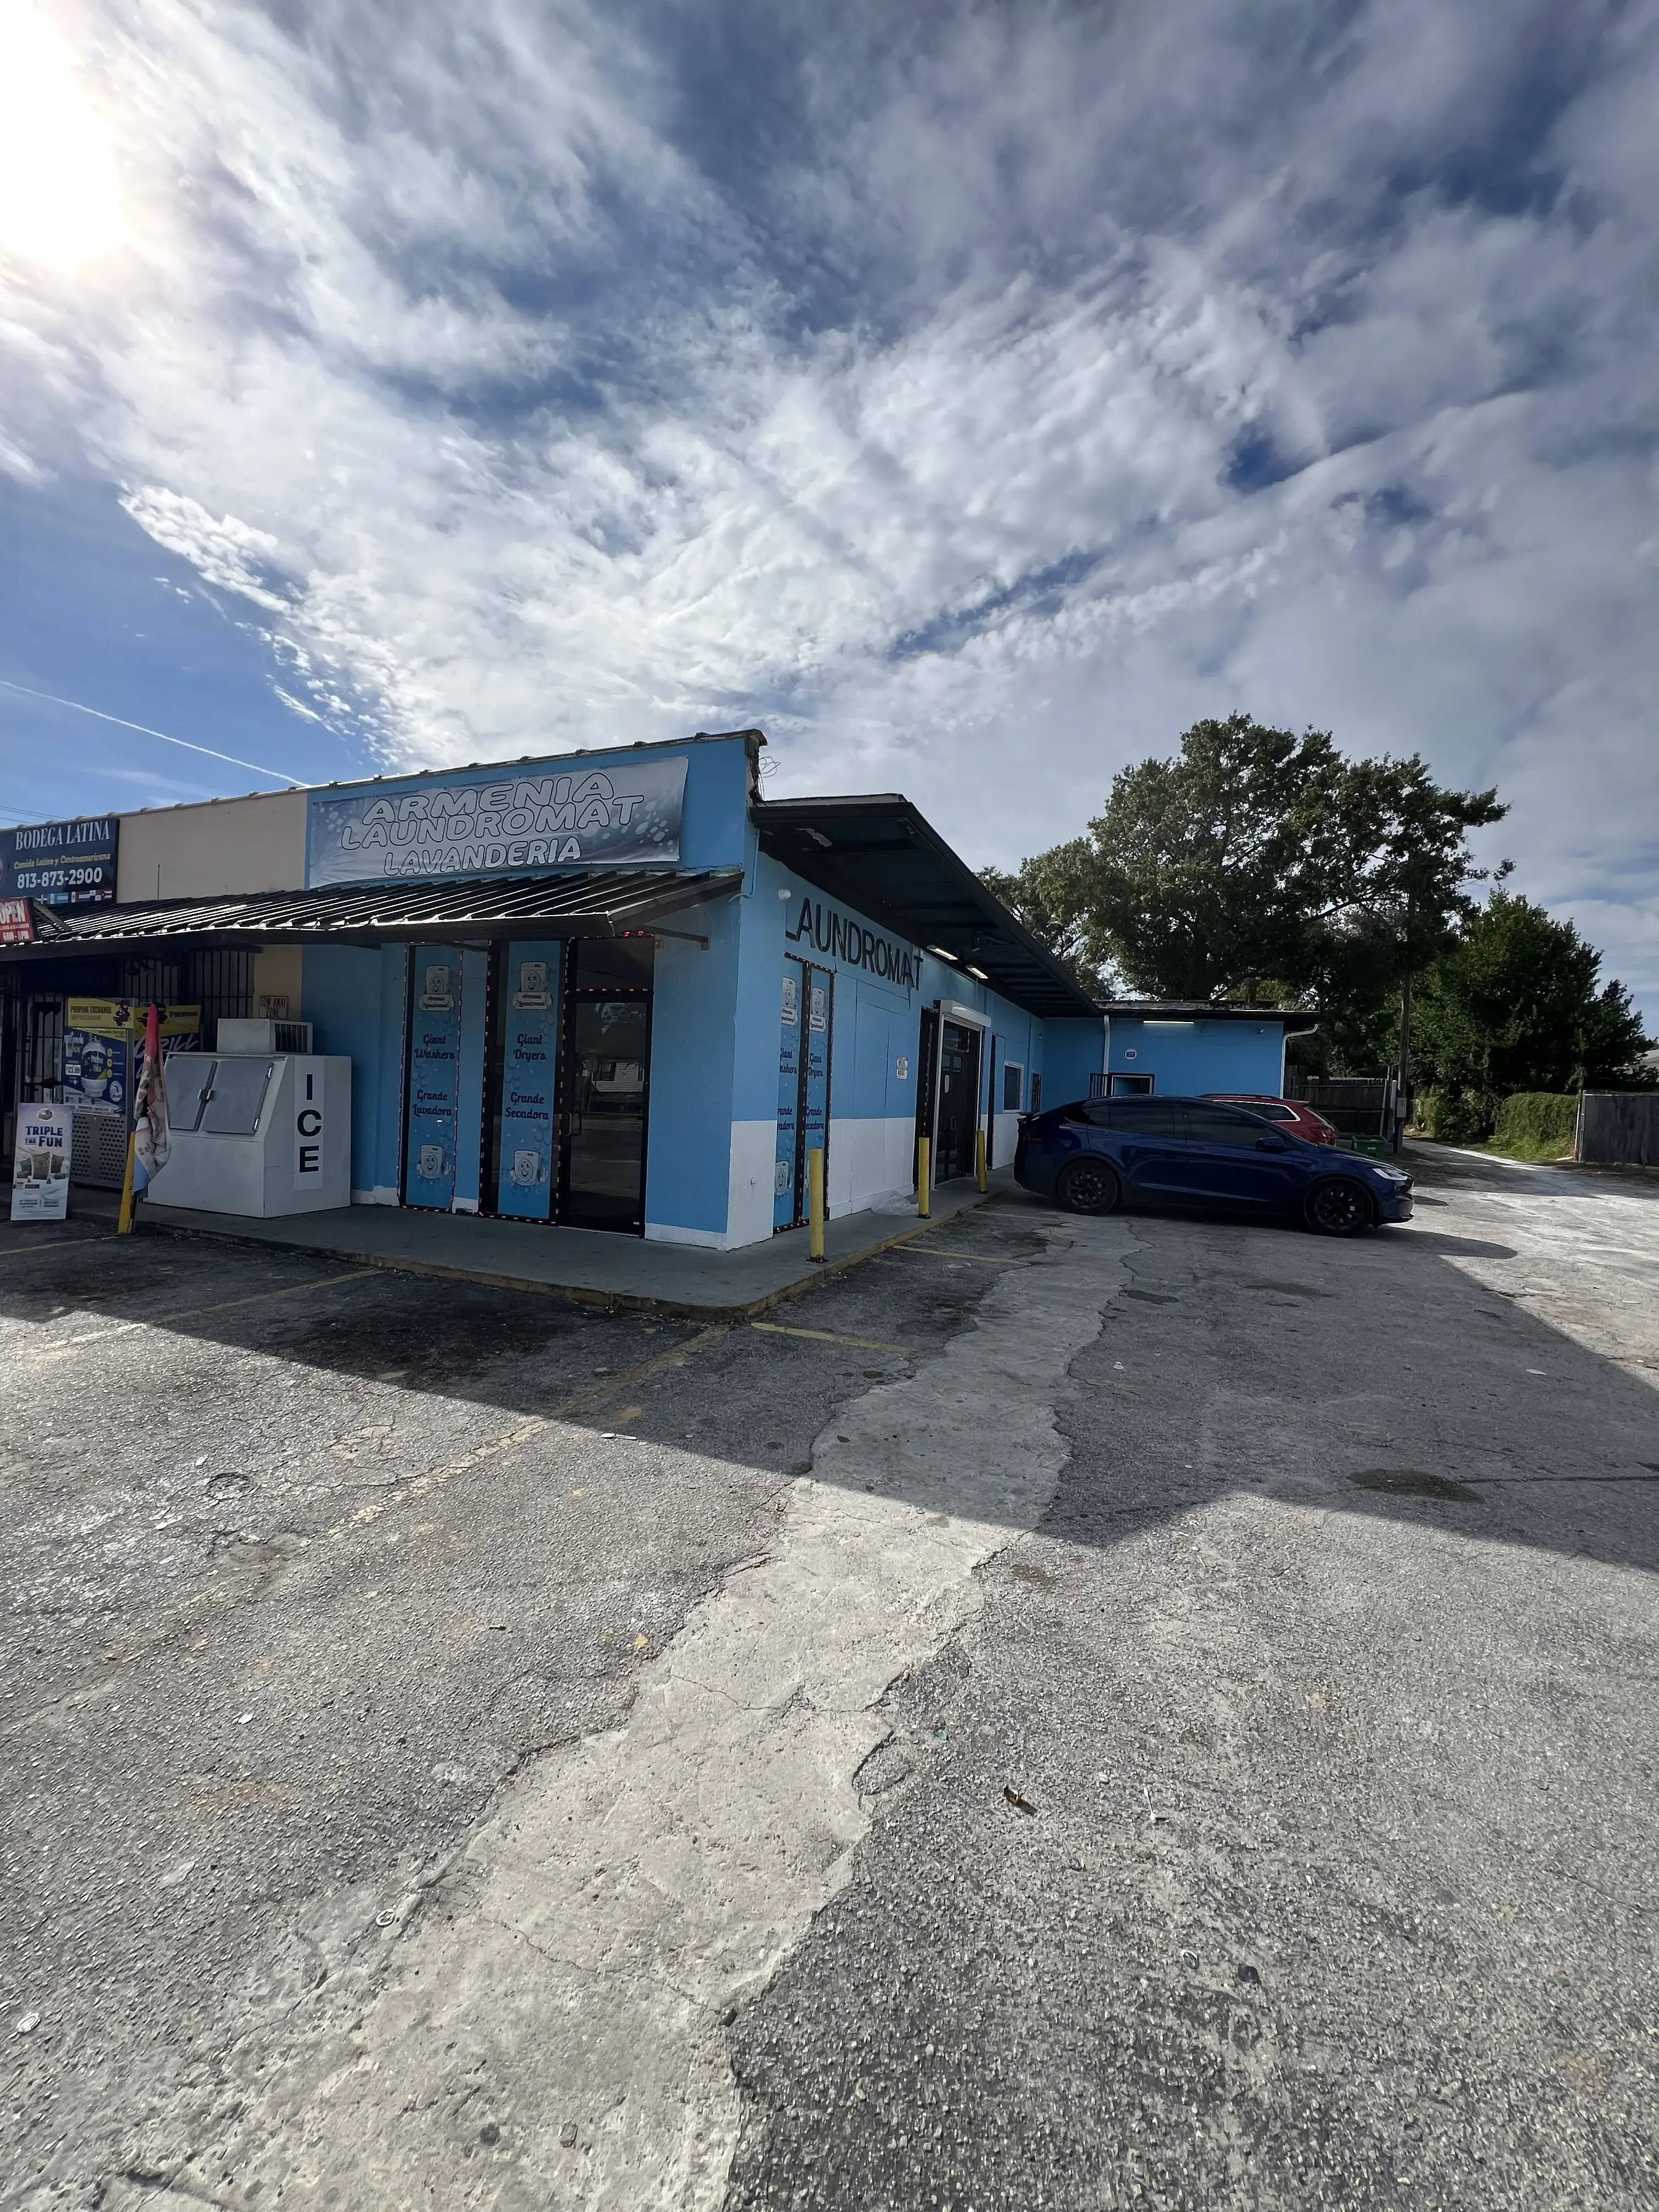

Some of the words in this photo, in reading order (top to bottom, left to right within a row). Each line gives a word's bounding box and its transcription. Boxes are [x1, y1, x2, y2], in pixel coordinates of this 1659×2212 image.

[363, 772, 614, 826] ARMENIA
[341, 795, 645, 850] LAUNDROMAT
[15, 827, 63, 850] BODEGA
[66, 820, 110, 844] LATINA
[383, 837, 581, 876] LAVANDERIA
[17, 867, 103, 889] 813-873-2900
[423, 1034, 446, 1047] Giant
[517, 1034, 543, 1047] Giant
[414, 1048, 455, 1060] Washers
[512, 1049, 547, 1063] Dryers
[417, 1090, 449, 1102] Grande
[510, 1092, 545, 1106] Grande
[412, 1104, 453, 1118] Lavadora
[504, 1107, 549, 1120] Secadora
[25, 1125, 63, 1136] TRIPLE
[297, 1074, 323, 1173] ICE
[38, 1136, 63, 1148] FUN
